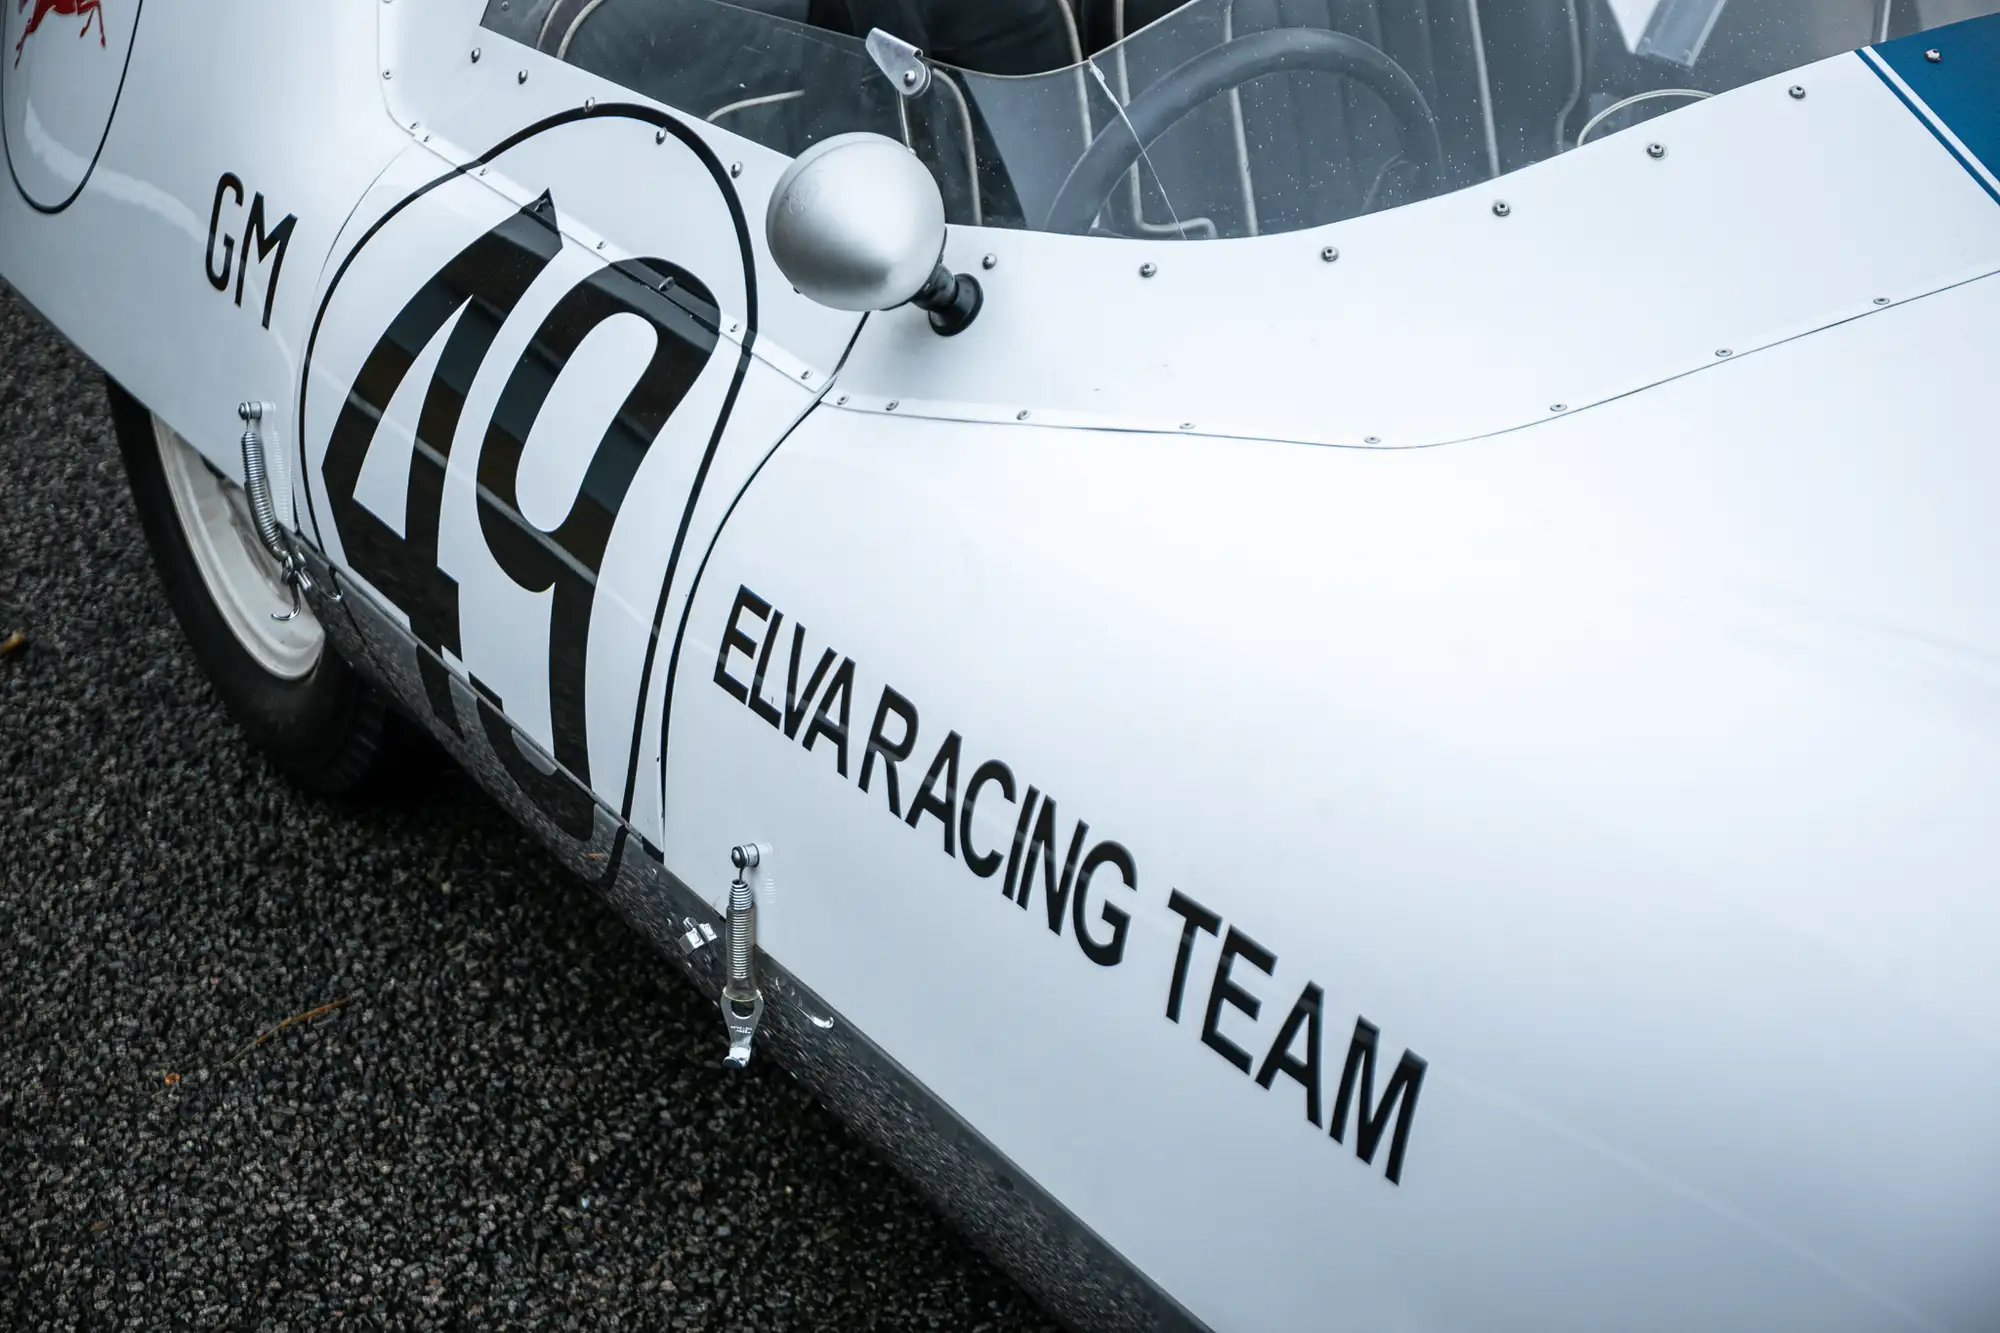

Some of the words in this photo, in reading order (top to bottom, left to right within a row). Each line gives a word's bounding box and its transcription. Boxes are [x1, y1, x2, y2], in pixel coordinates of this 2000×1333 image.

[205, 171, 298, 331] GM
[322, 187, 720, 842] 49
[712, 584, 856, 779] ELVA
[857, 684, 1137, 967] RACING
[1165, 888, 1429, 1186] TEAM
